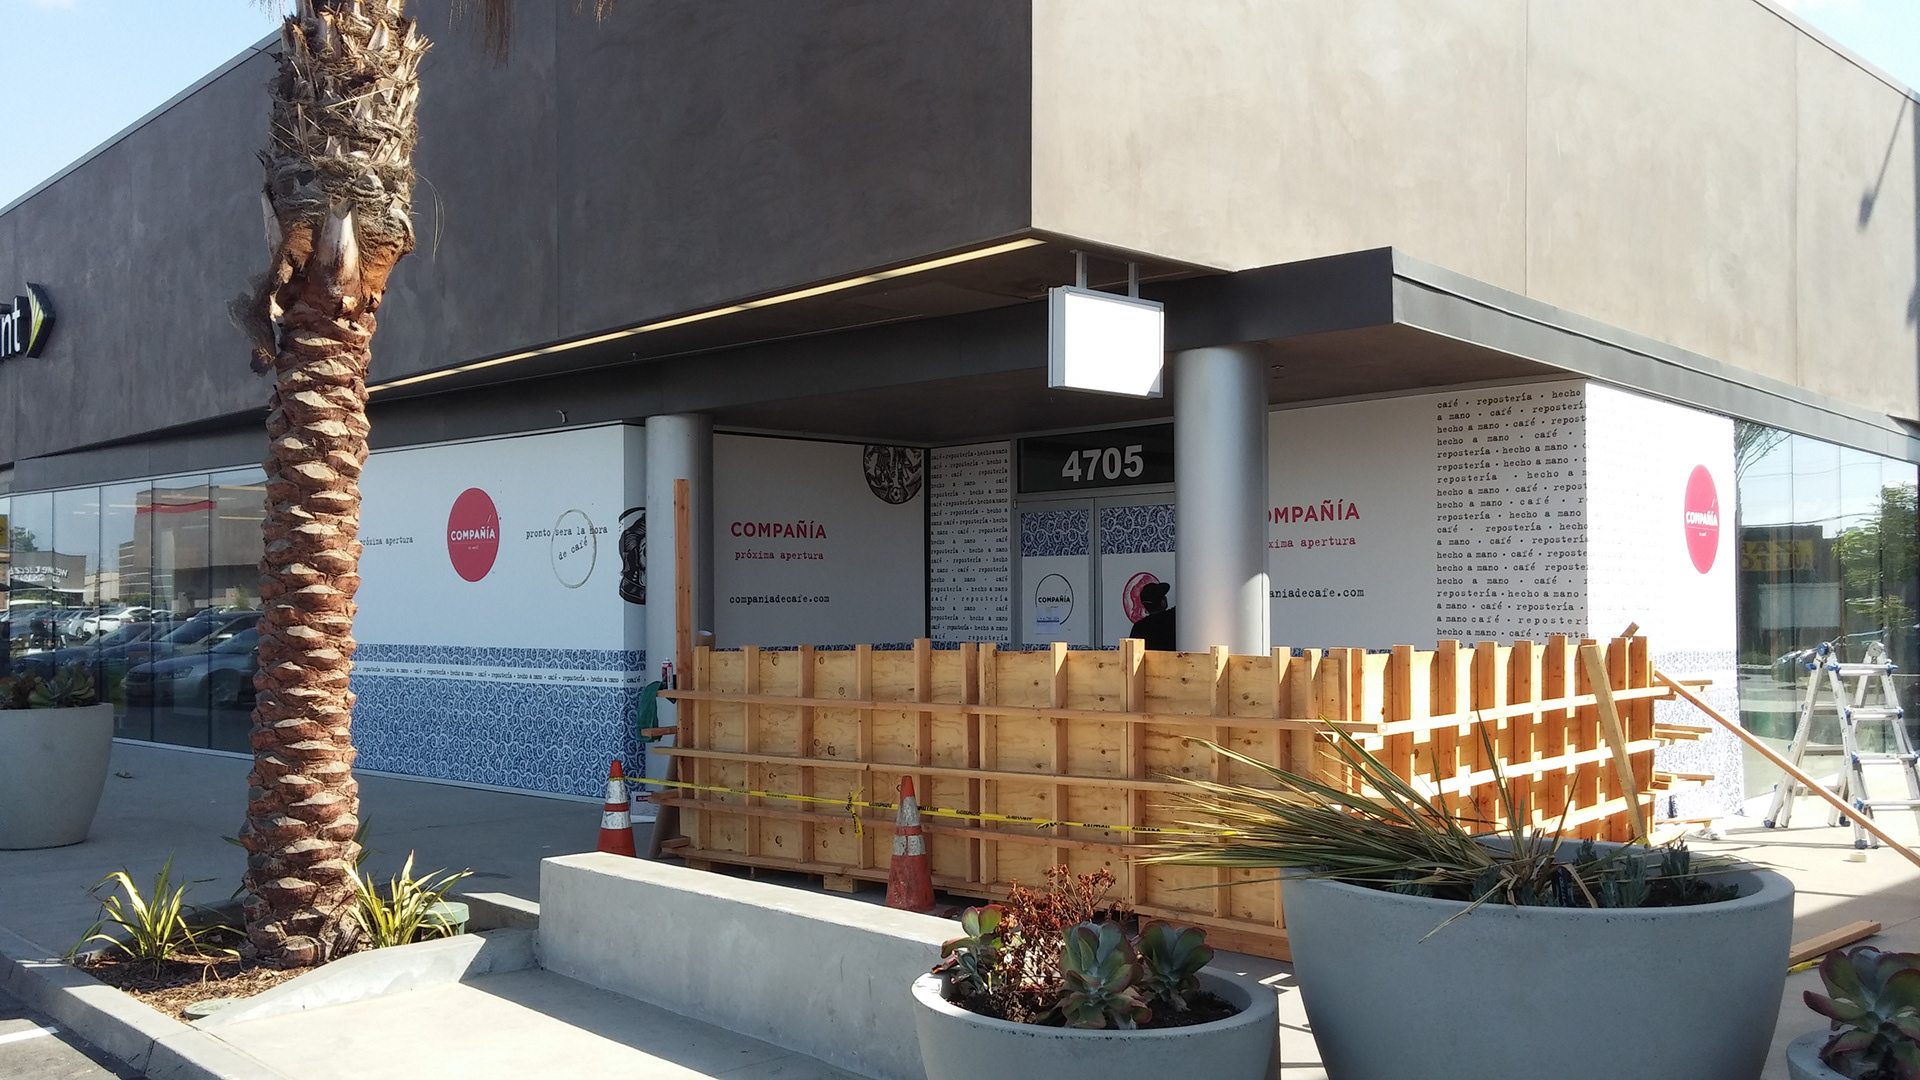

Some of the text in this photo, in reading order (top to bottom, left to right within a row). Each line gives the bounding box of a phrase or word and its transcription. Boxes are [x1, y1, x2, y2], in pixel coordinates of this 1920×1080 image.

[1437, 389, 1580, 408] café repostería hecho
[1490, 406, 1512, 416] café
[1437, 425, 1463, 433] hecho
[1513, 417, 1535, 427] café
[1437, 437, 1463, 446] hecho
[1534, 428, 1557, 439] café
[1437, 447, 1490, 459] repostería
[1502, 446, 1530, 454] hecho
[1061, 445, 1144, 482] 4705
[1437, 460, 1490, 472] repostería
[1503, 459, 1531, 467] hecho
[1437, 472, 1497, 484] repostería
[1527, 470, 1559, 479] hecho
[1437, 488, 1463, 496] hecho
[1515, 483, 1537, 493] café
[1437, 501, 1463, 509] hecho
[1520, 496, 1549, 505] café
[1437, 511, 1490, 522] repostería
[1509, 511, 1537, 519] hecho
[1685, 510, 1718, 527] COMPAÑÍA
[450, 525, 496, 541] COMPAÑÍA
[526, 525, 608, 540] pronto sera la hora
[730, 520, 827, 539] COMPAÑÍA
[1437, 522, 1587, 533] café repostería hecho
[385, 536, 413, 545] apertura
[1300, 536, 1356, 549] apertura
[1490, 535, 1511, 545] café
[558, 535, 588, 561] de café
[1511, 549, 1533, 557] café
[735, 549, 824, 561] próxima apertura
[1513, 562, 1535, 571] café
[1534, 575, 1557, 584] café
[1038, 594, 1071, 603] COMPAÑÍA
[1437, 588, 1497, 598] repostería
[729, 594, 830, 605] companiadecafe.com
[1481, 601, 1502, 610] café
[1516, 602, 1574, 612] repostería
[1471, 614, 1499, 623] café
[1509, 629, 1531, 637] café
